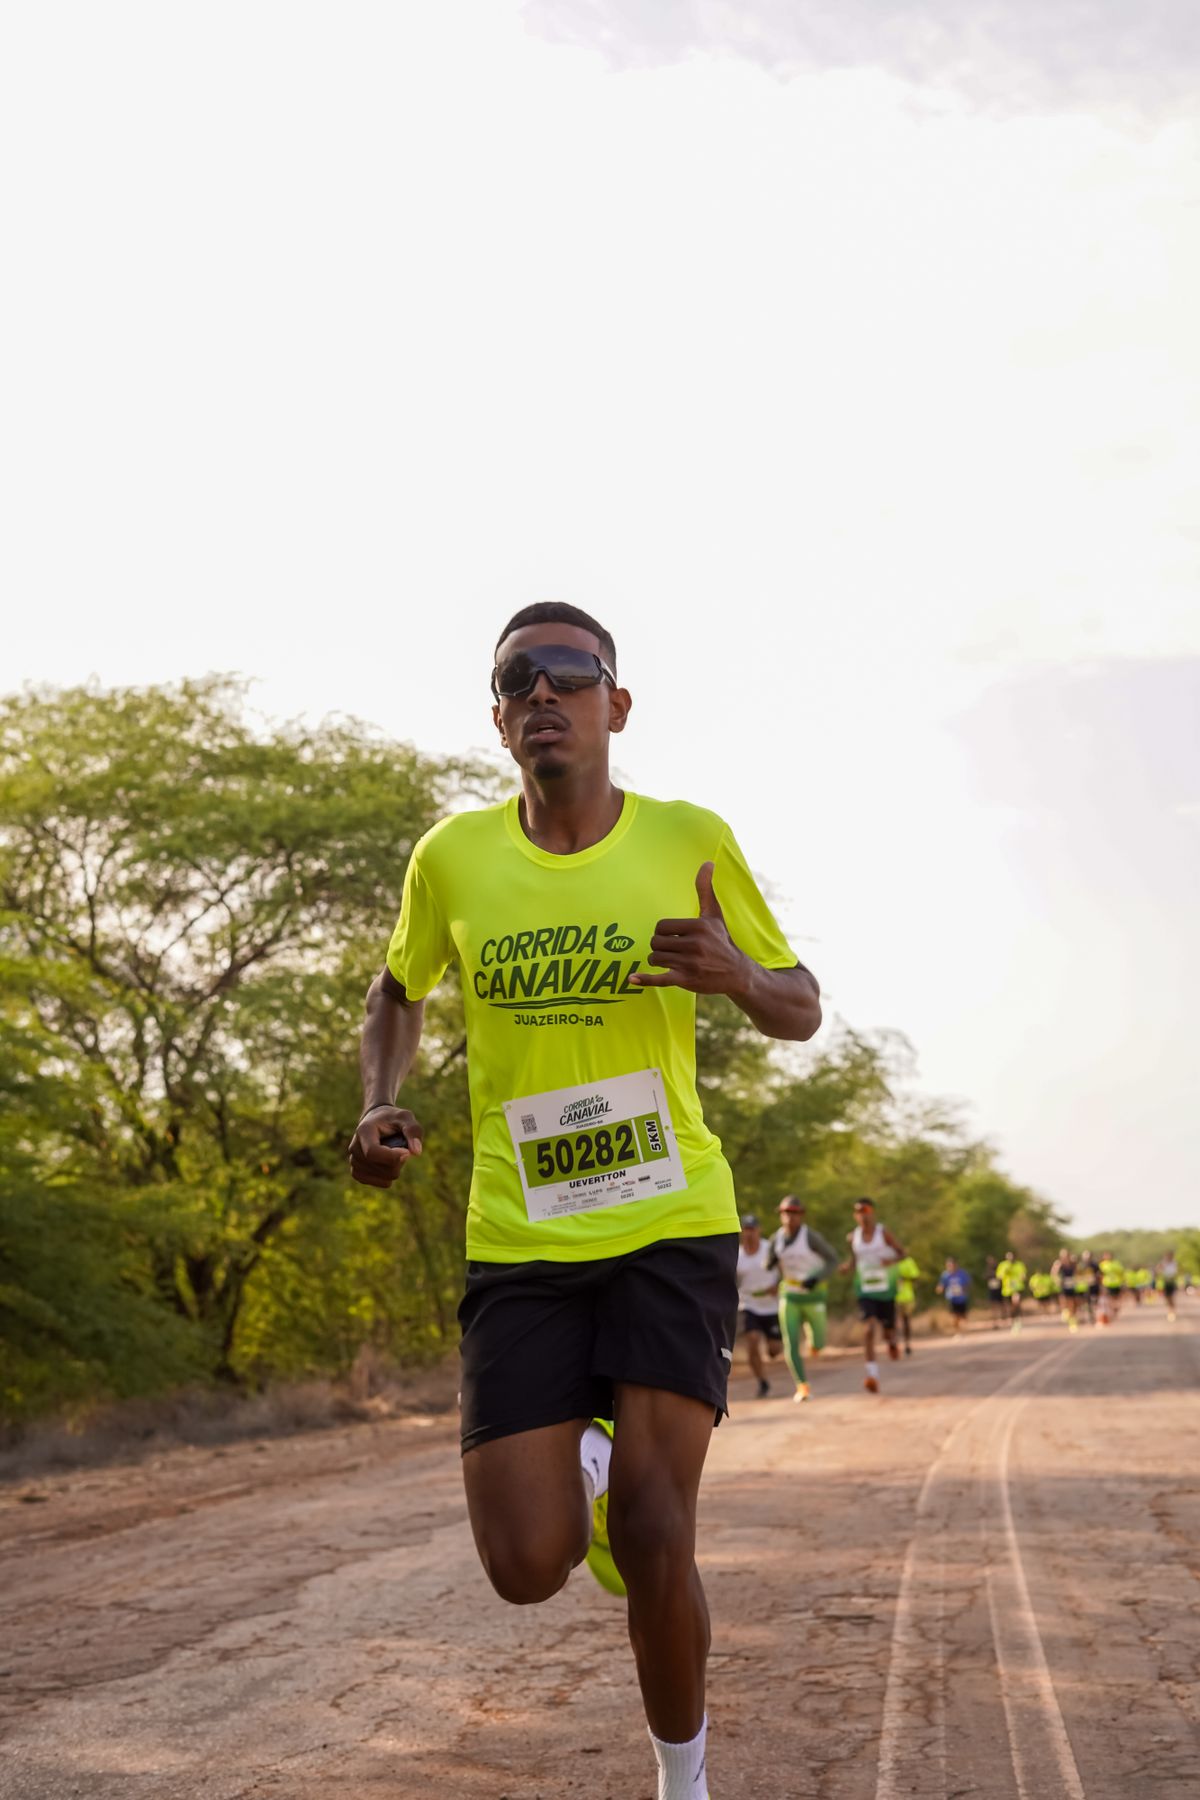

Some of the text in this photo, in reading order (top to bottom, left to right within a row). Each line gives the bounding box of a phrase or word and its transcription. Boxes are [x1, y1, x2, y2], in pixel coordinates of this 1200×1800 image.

[481, 925, 628, 967] CORRIDA NO
[474, 959, 644, 999] CANAVIAL
[514, 1014, 604, 1027] JUAZEIRO-BA
[560, 1101, 612, 1126] CANAVIAL
[564, 1097, 595, 1113] CORRIDA
[645, 1119, 662, 1153] 5KM
[537, 1124, 635, 1178] 50282
[569, 1170, 626, 1188] UEVERTTON
